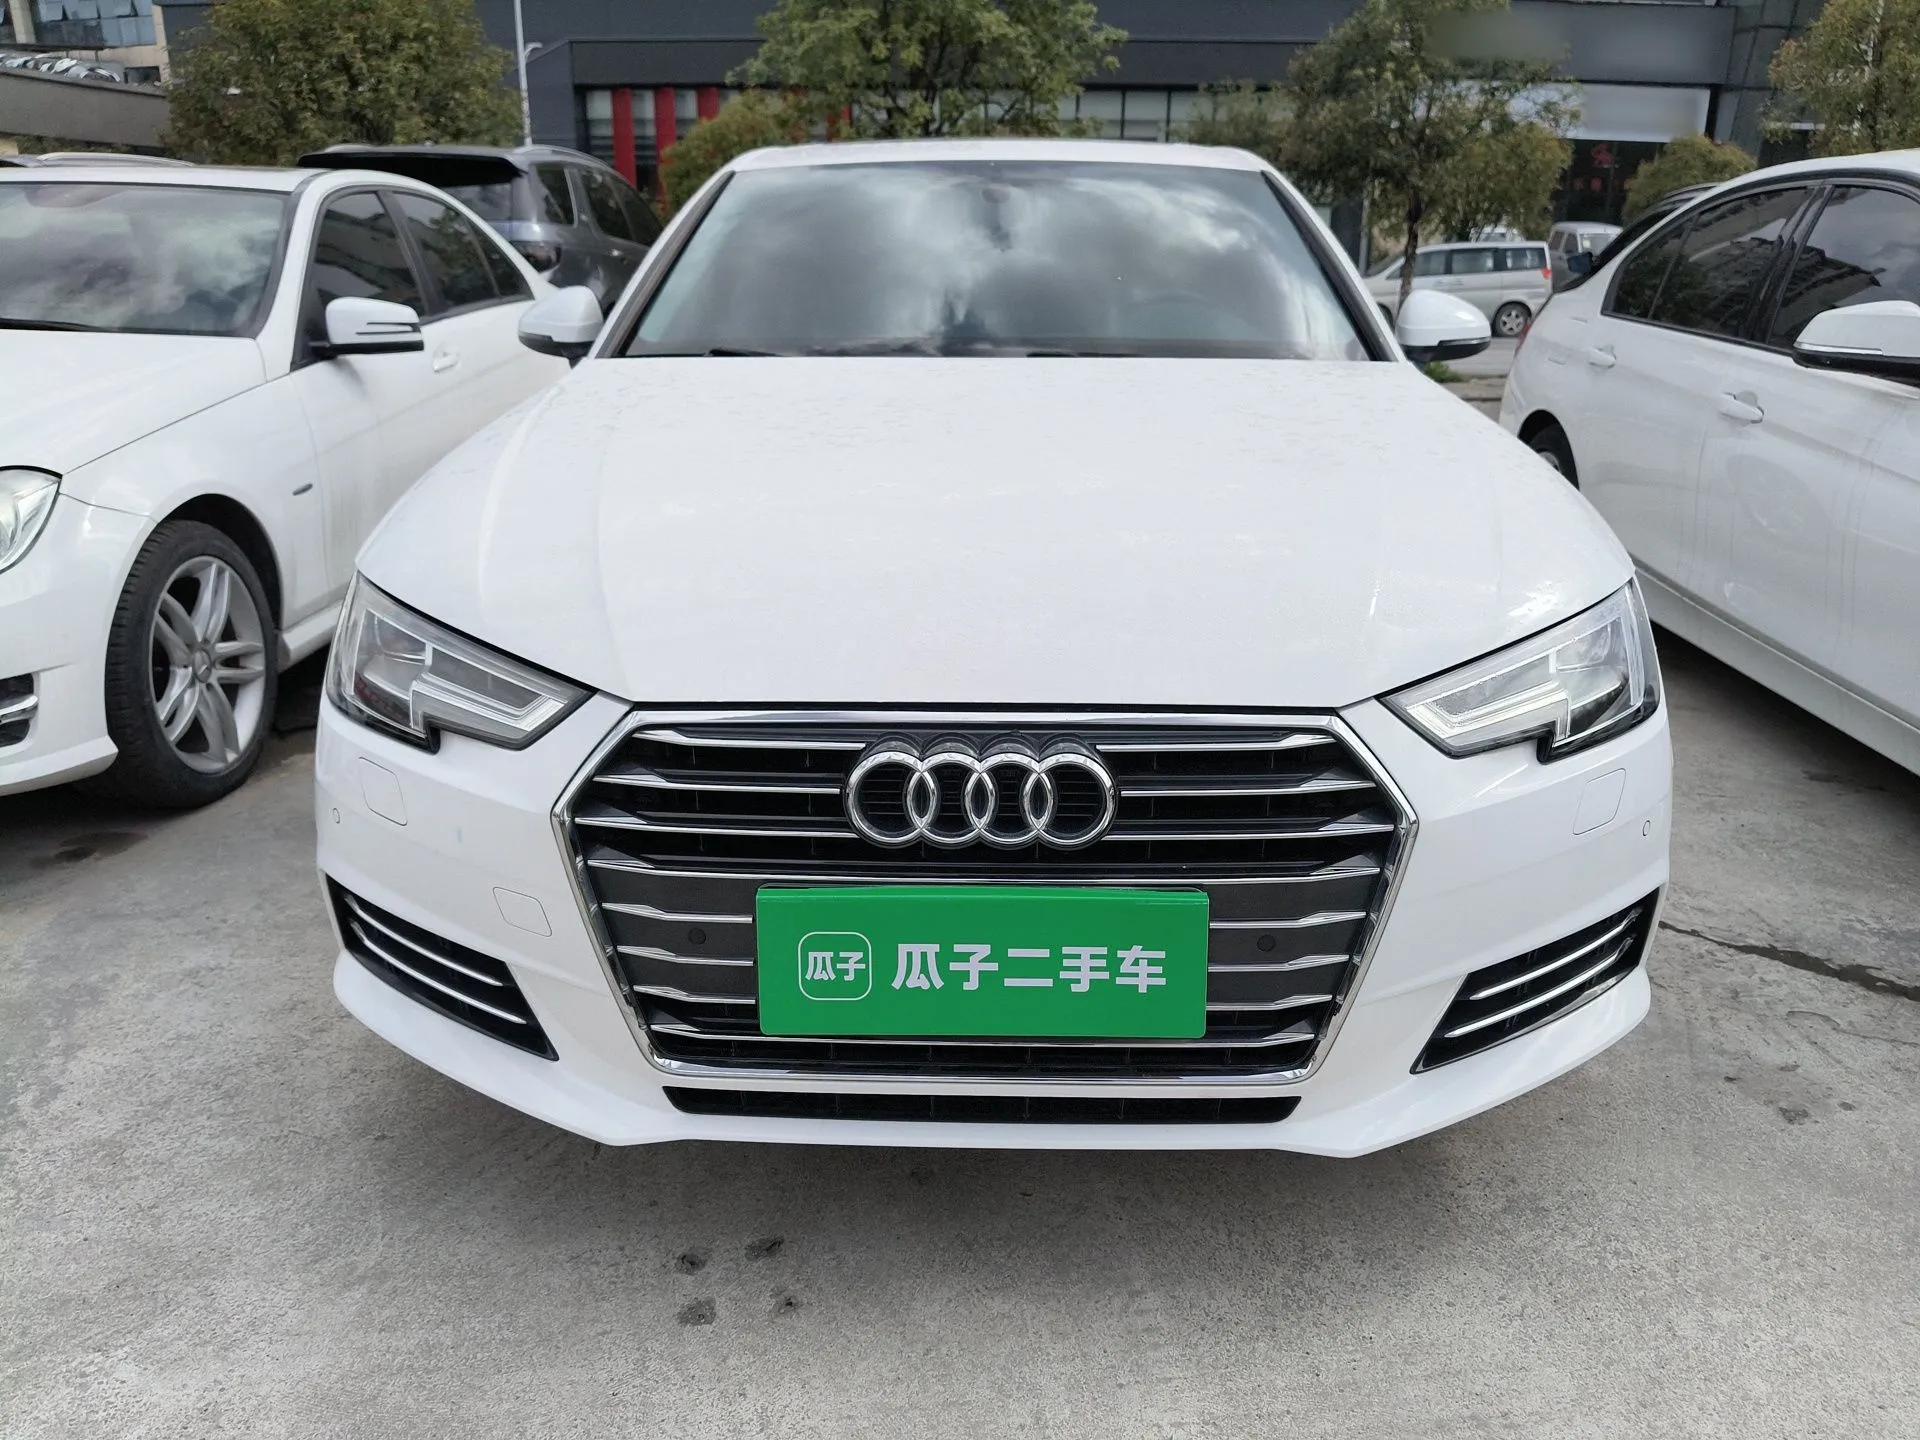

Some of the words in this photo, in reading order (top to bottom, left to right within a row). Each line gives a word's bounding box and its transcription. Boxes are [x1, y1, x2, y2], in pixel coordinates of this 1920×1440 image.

[805, 951, 866, 982] 瓜子
[891, 943, 1167, 994] 瓜子二手车
